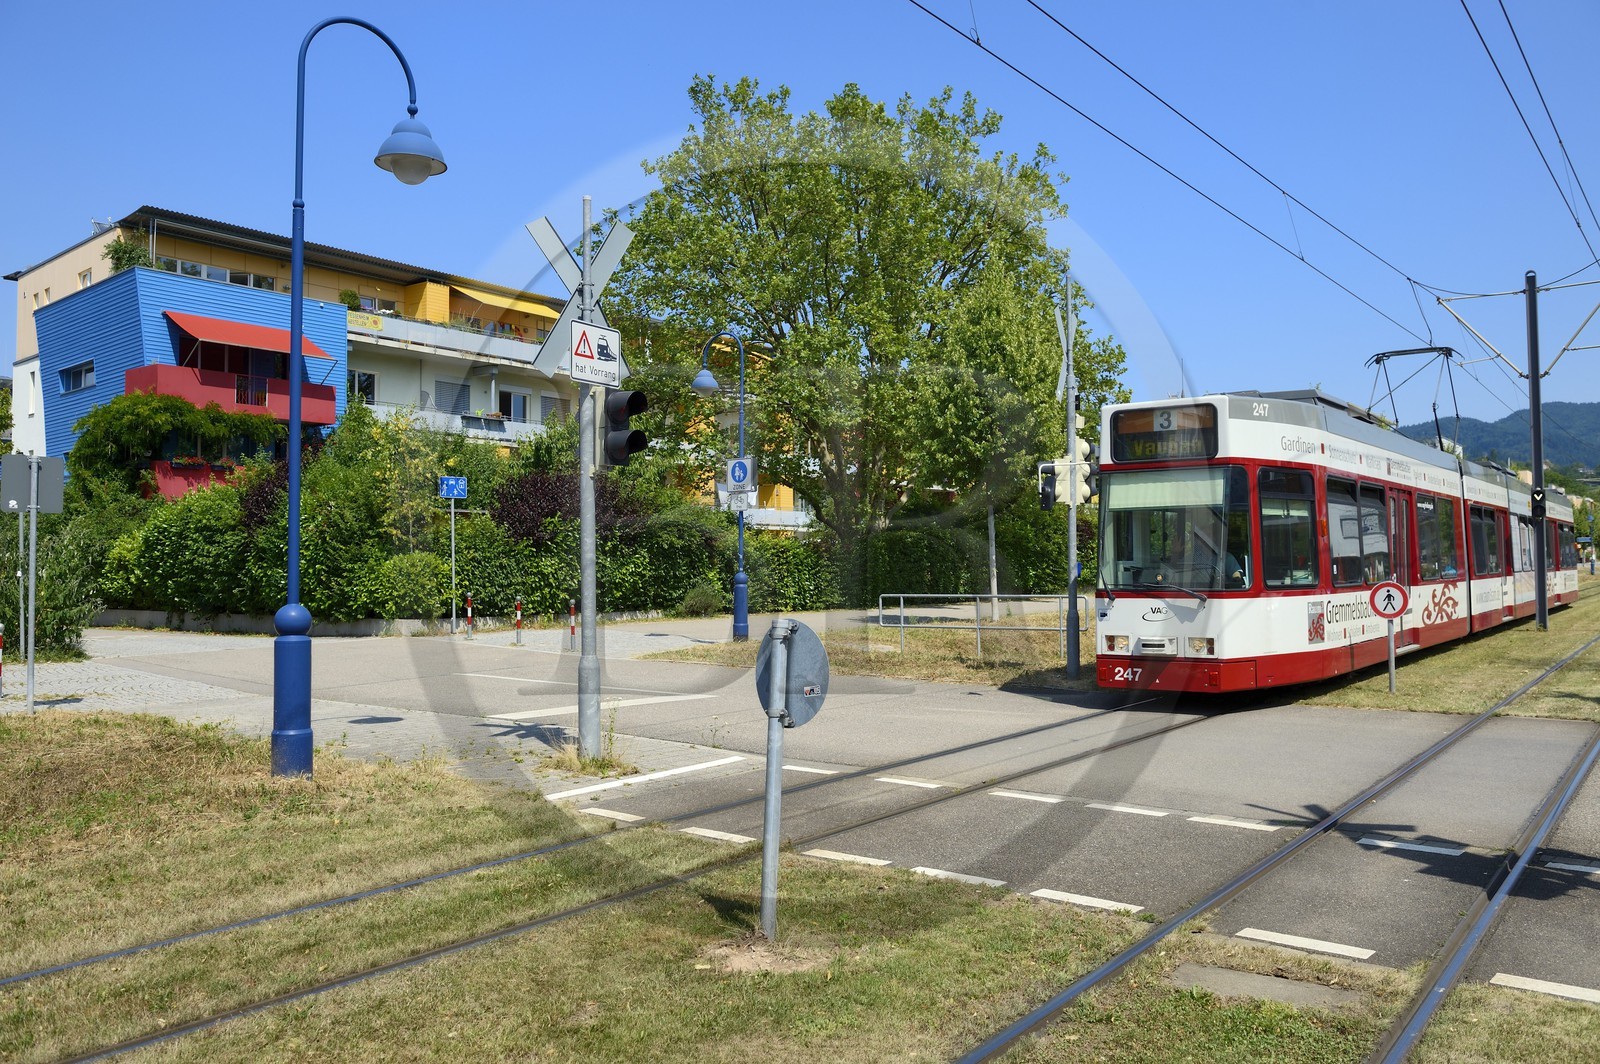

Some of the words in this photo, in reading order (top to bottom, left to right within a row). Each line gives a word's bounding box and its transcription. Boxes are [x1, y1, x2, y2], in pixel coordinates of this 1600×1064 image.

[575, 363, 586, 373] hat
[590, 366, 616, 381] Vorrang
[1253, 402, 1269, 416] 247
[1159, 411, 1172, 429] 3
[1281, 436, 1315, 454] Gardinen
[1114, 667, 1142, 681] 247
